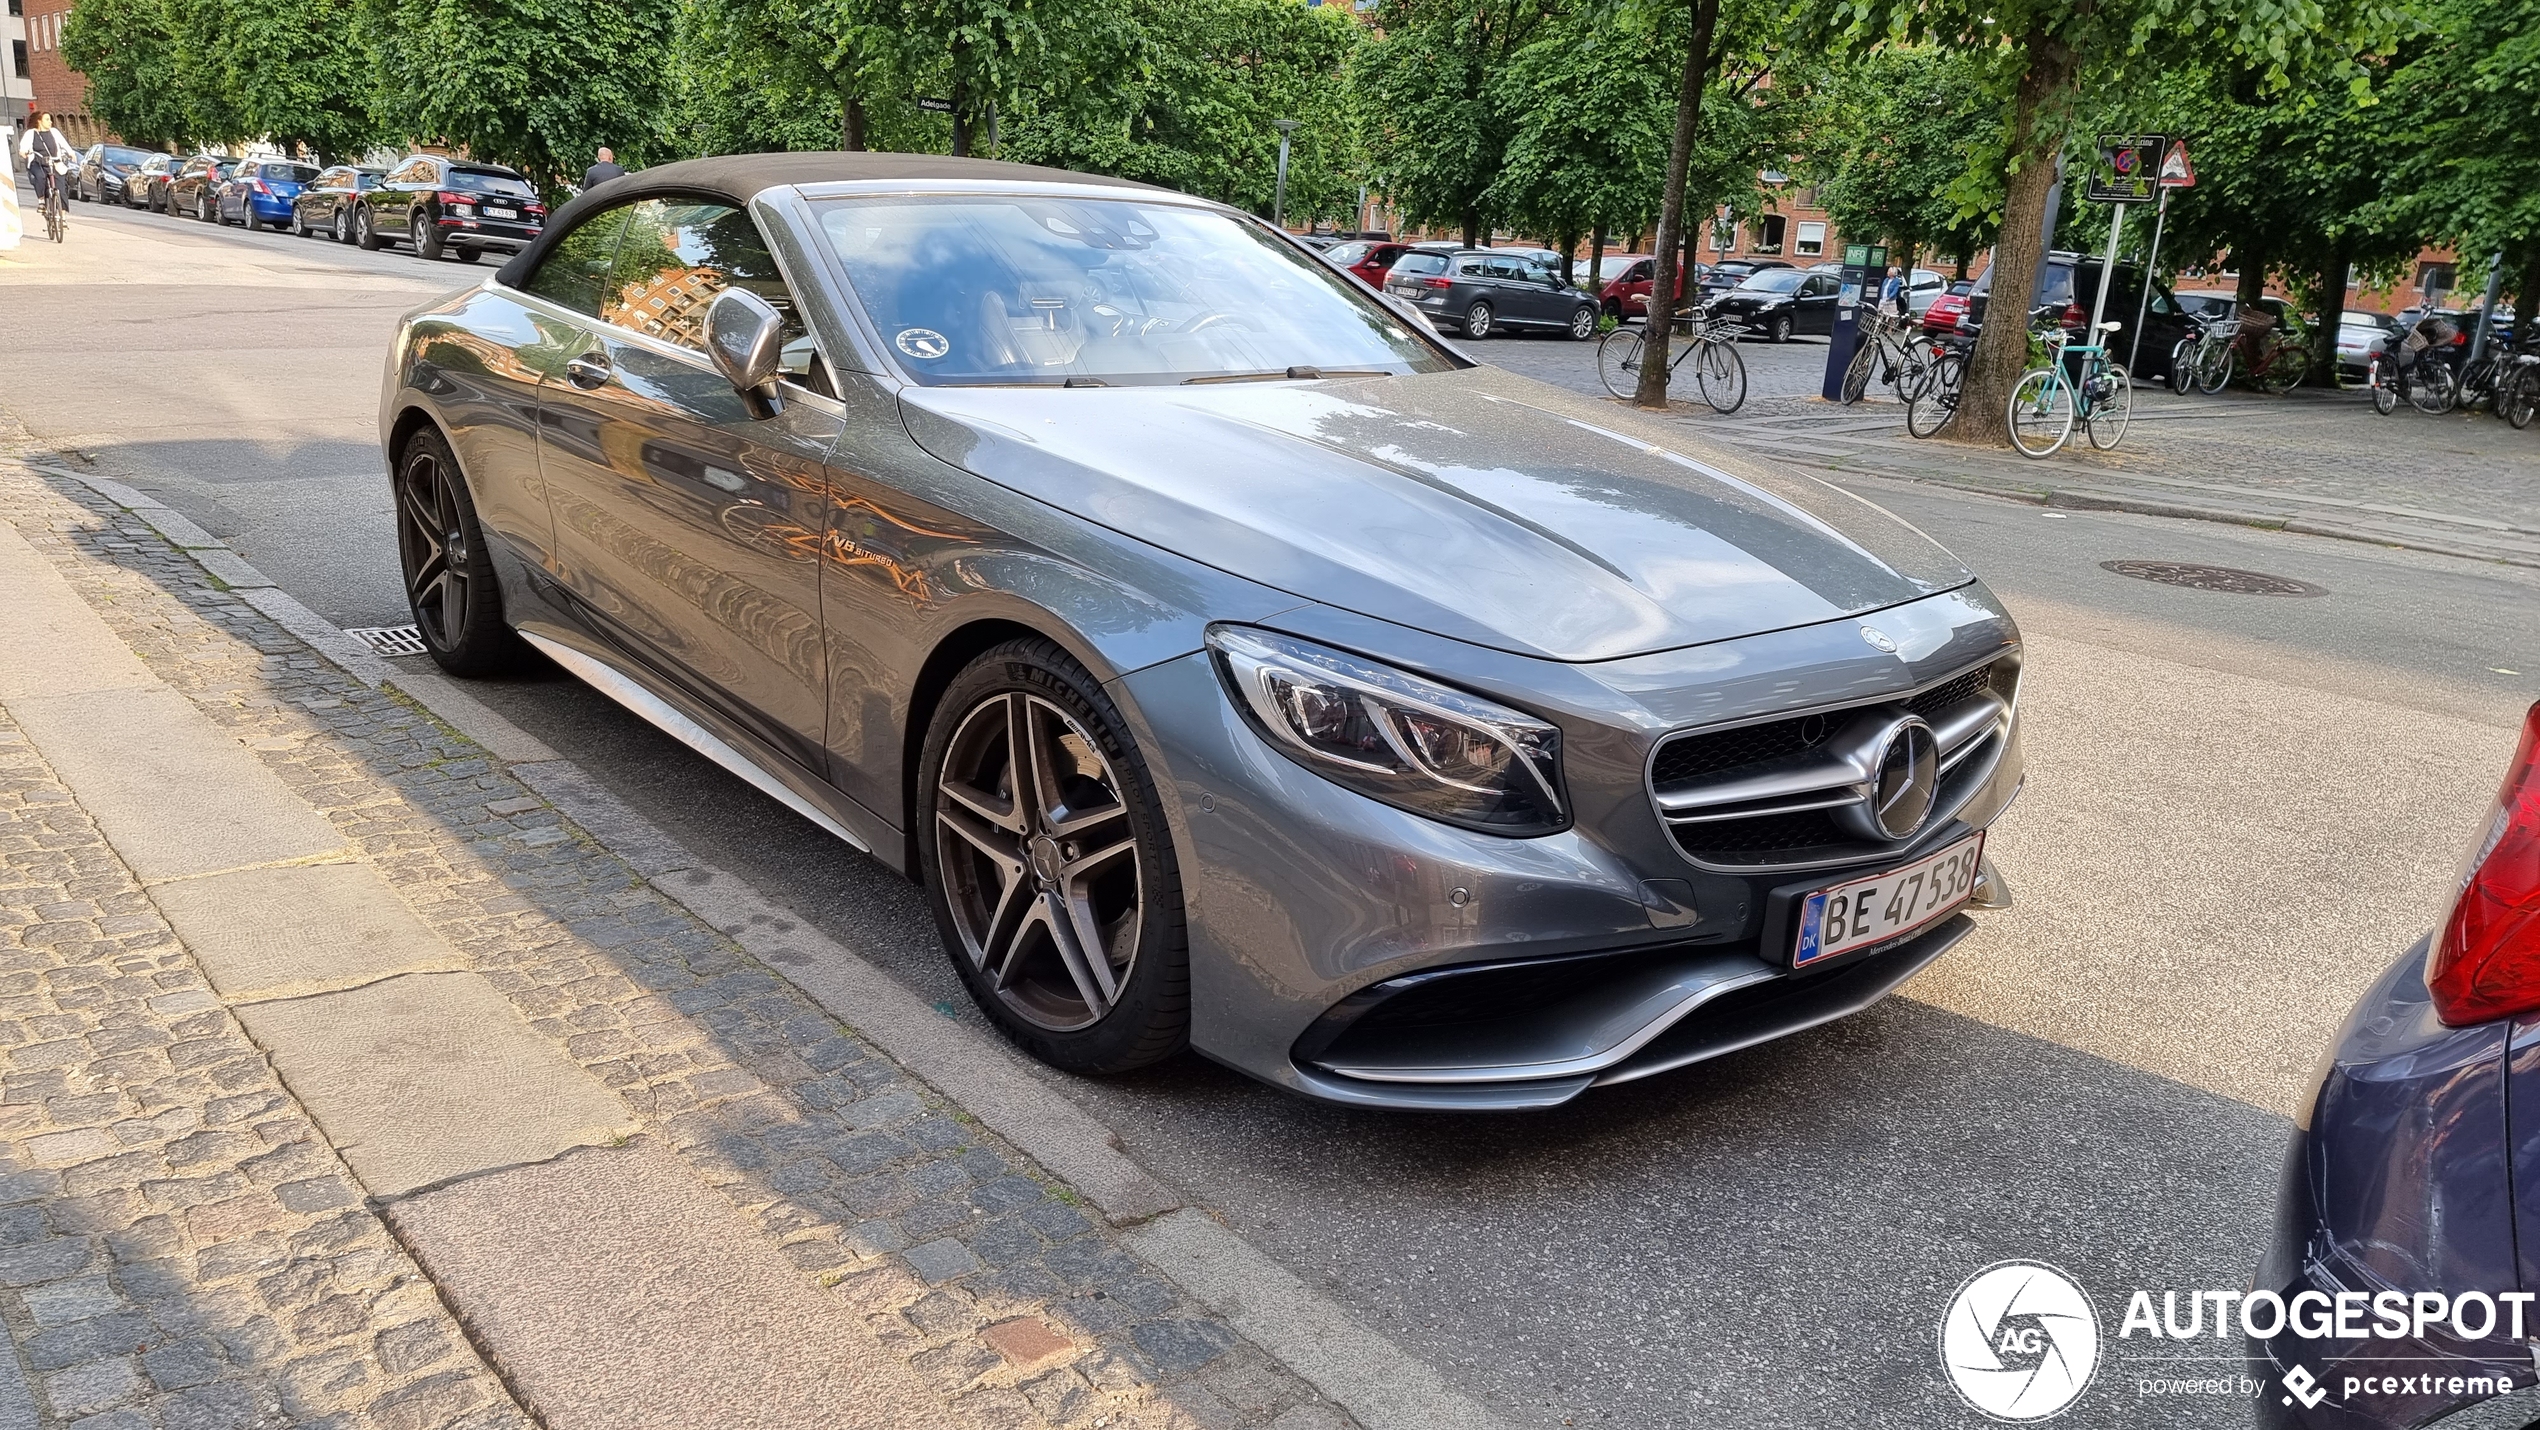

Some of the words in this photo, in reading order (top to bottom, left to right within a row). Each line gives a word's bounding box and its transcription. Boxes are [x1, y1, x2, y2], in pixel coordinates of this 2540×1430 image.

[920, 99, 951, 109] Adelgade
[1847, 249, 1866, 259] INFO
[1872, 251, 1883, 260] INFO
[833, 535, 856, 552] V8
[855, 547, 893, 567] BITURBO
[1029, 667, 1120, 753] MICHELIN
[1124, 768, 1143, 806] PILOT
[1141, 813, 1157, 860] SPORT
[1824, 888, 1878, 946] BE
[1802, 934, 1817, 951] DK
